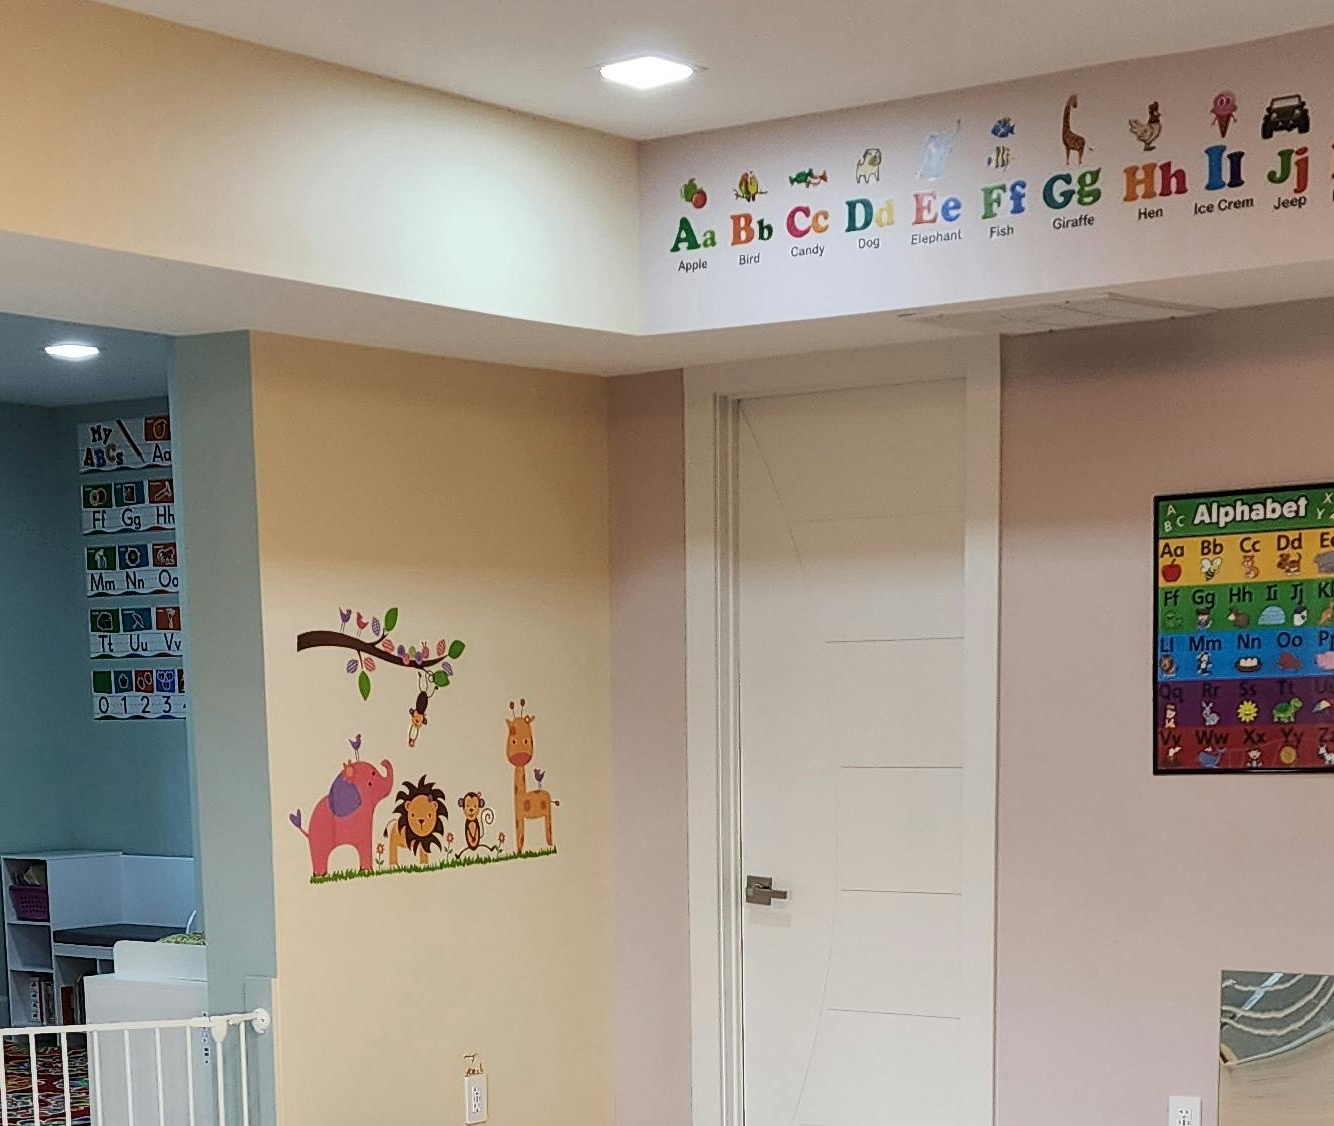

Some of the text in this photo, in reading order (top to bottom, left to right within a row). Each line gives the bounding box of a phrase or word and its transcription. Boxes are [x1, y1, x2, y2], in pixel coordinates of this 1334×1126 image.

[670, 217, 716, 253] Aa
[730, 212, 773, 246] Bb
[786, 205, 830, 238] Cc
[845, 197, 895, 233] Dd
[912, 189, 962, 226] Ee
[980, 179, 1027, 220] Ff
[1042, 167, 1103, 210] Gg
[1123, 160, 1188, 202] Hh
[1266, 146, 1310, 194] Jj
[678, 258, 708, 273] Apple
[739, 251, 760, 267] Bird
[790, 243, 825, 259] Candy
[858, 235, 880, 251] Dog
[910, 228, 963, 246] Elephant
[990, 223, 1014, 240] Fish
[1052, 214, 1095, 232] Giraffe
[1137, 204, 1164, 222] Hen
[1194, 199, 1214, 215] Ice
[1217, 196, 1255, 212] Crem
[1273, 195, 1308, 210] Jeep
[90, 424, 113, 445] My
[83, 443, 124, 468] ABCs
[92, 505, 175, 530] Ff Gg Hh
[1193, 496, 1309, 528] Alphabet
[1160, 543, 1184, 558] Aa
[1200, 539, 1224, 556] Bb
[1239, 537, 1261, 553] Cc
[1276, 533, 1303, 550] Dd
[90, 569, 179, 591] Mm Nn Oo
[1163, 591, 1180, 607] Ff
[1191, 589, 1216, 609] Gg
[1229, 587, 1253, 602] Hh
[1290, 583, 1304, 605] Jj
[98, 633, 181, 652] Tt Uu Vv
[1188, 636, 1222, 651] Mm
[1237, 634, 1262, 649] Nn
[1277, 631, 1303, 647] Oo
[1195, 730, 1229, 745] Ww
[1243, 728, 1267, 744] Xx
